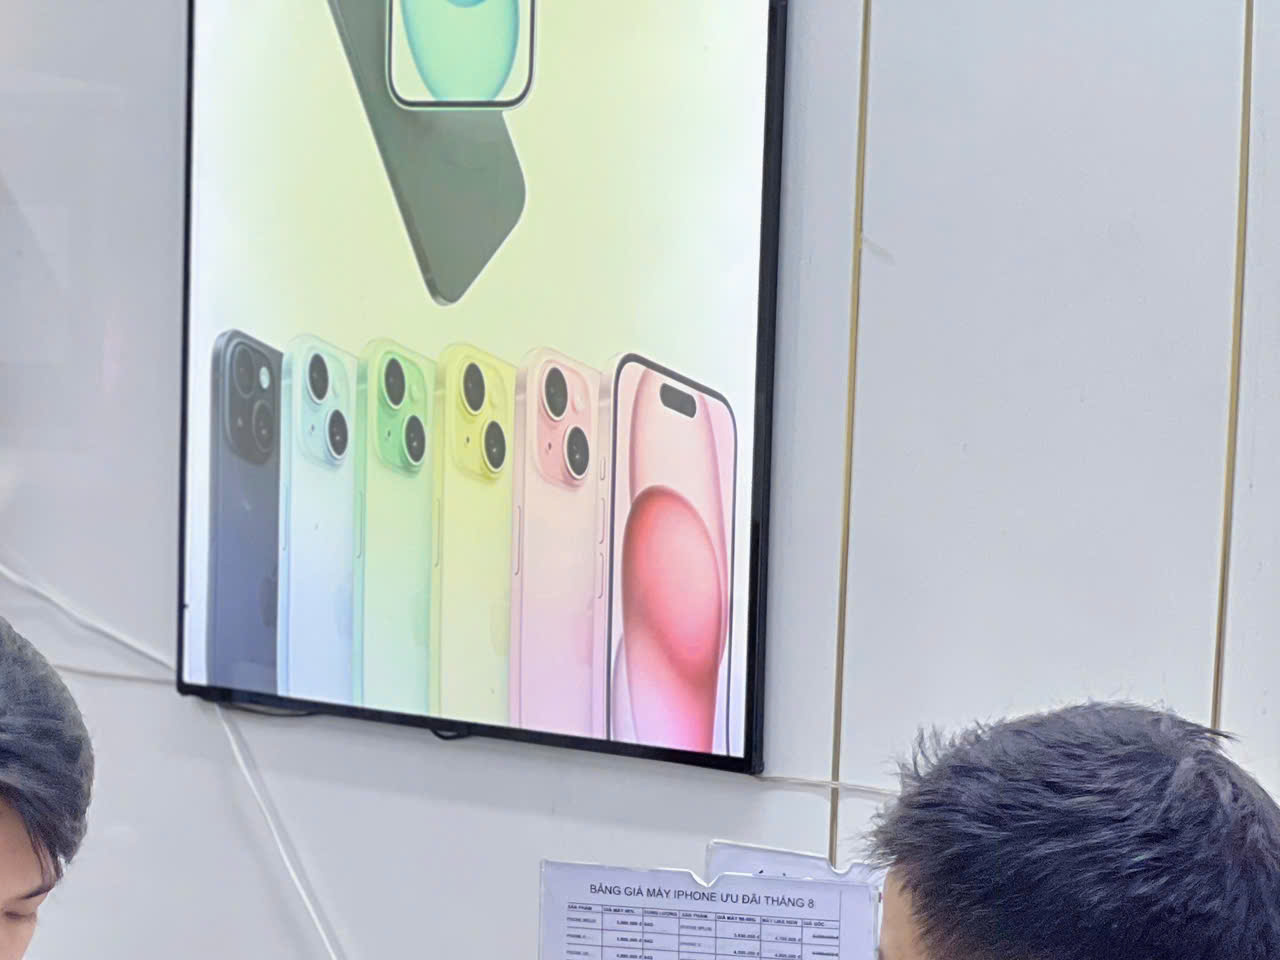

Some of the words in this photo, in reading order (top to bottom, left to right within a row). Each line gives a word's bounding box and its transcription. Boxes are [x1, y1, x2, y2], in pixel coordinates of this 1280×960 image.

[589, 882, 622, 897] BẢNG
[624, 885, 644, 898] GIÁ
[646, 886, 671, 899] MÁY
[673, 890, 718, 902] IPHONE
[720, 892, 739, 904] ƯU
[741, 892, 762, 905] ĐÃI
[763, 893, 805, 908] THÁNG
[807, 898, 815, 909] 8
